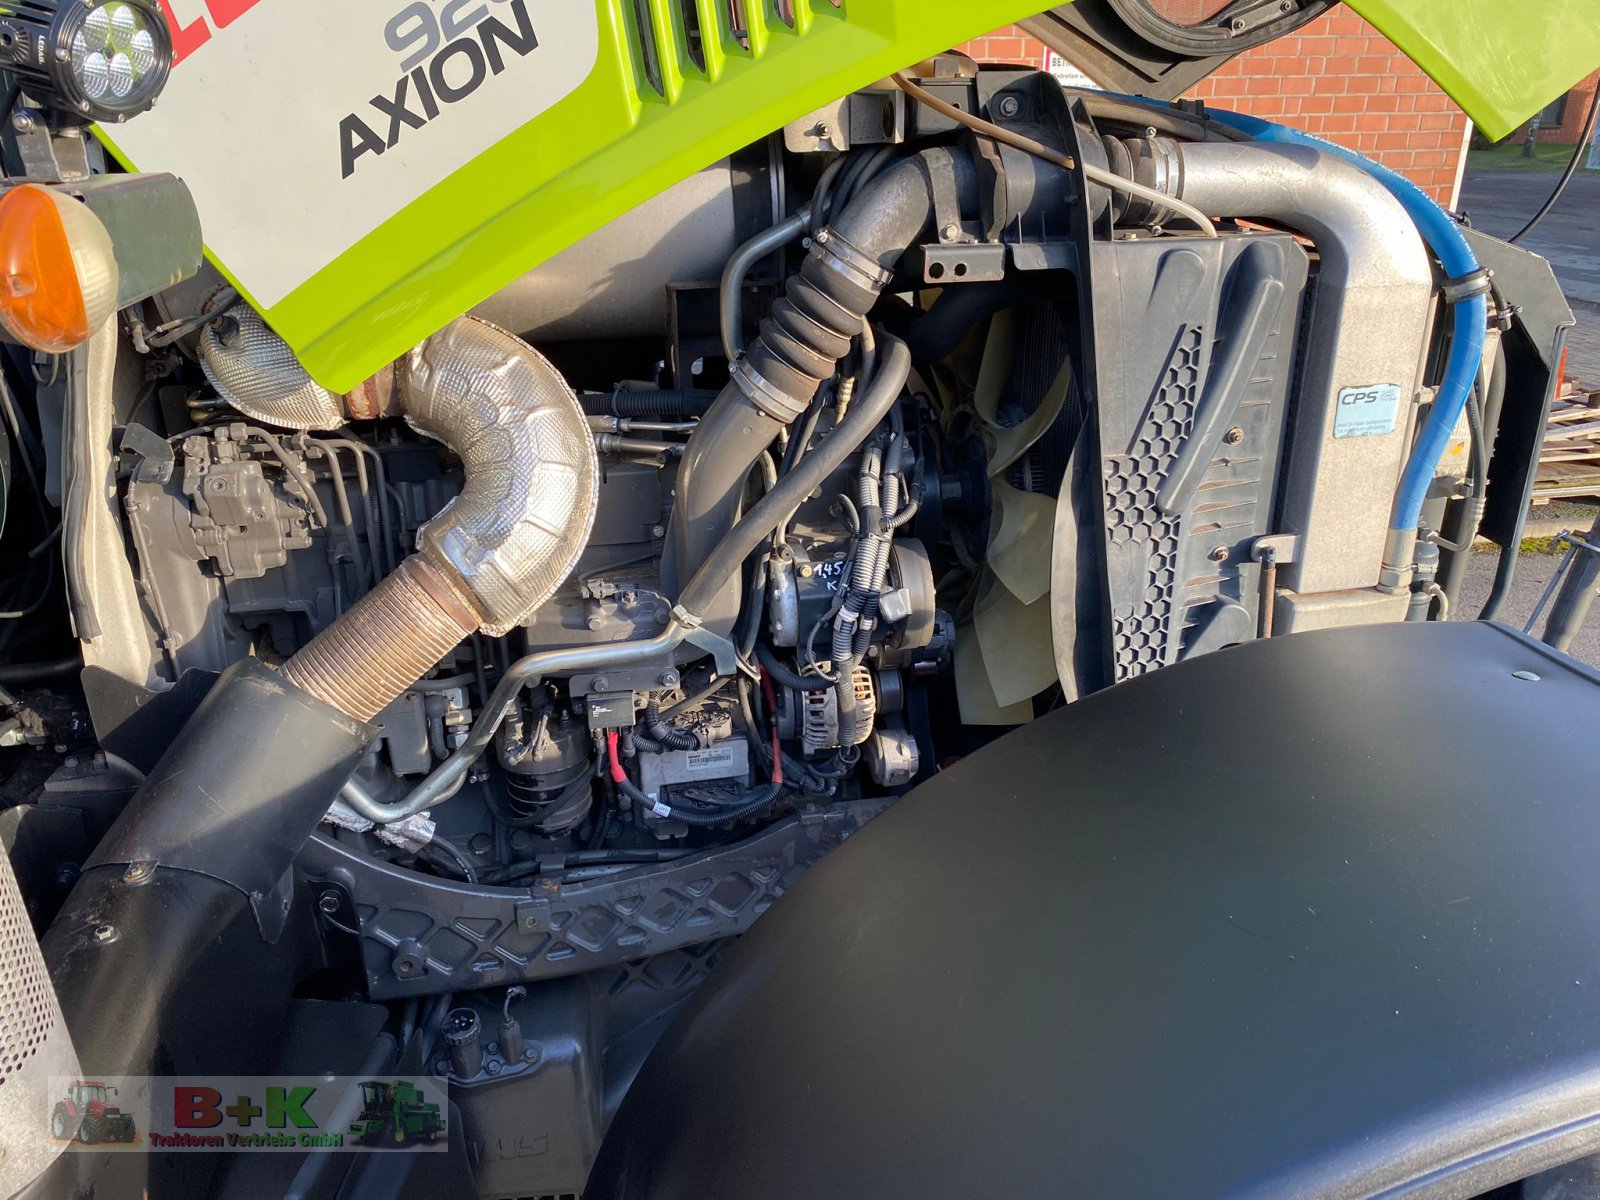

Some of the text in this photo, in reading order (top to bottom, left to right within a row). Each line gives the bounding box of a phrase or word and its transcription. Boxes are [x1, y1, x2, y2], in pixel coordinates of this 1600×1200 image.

[384, 0, 509, 73] 92
[339, 0, 539, 180] AXION
[1341, 391, 1379, 405] CPS
[826, 580, 838, 591] K
